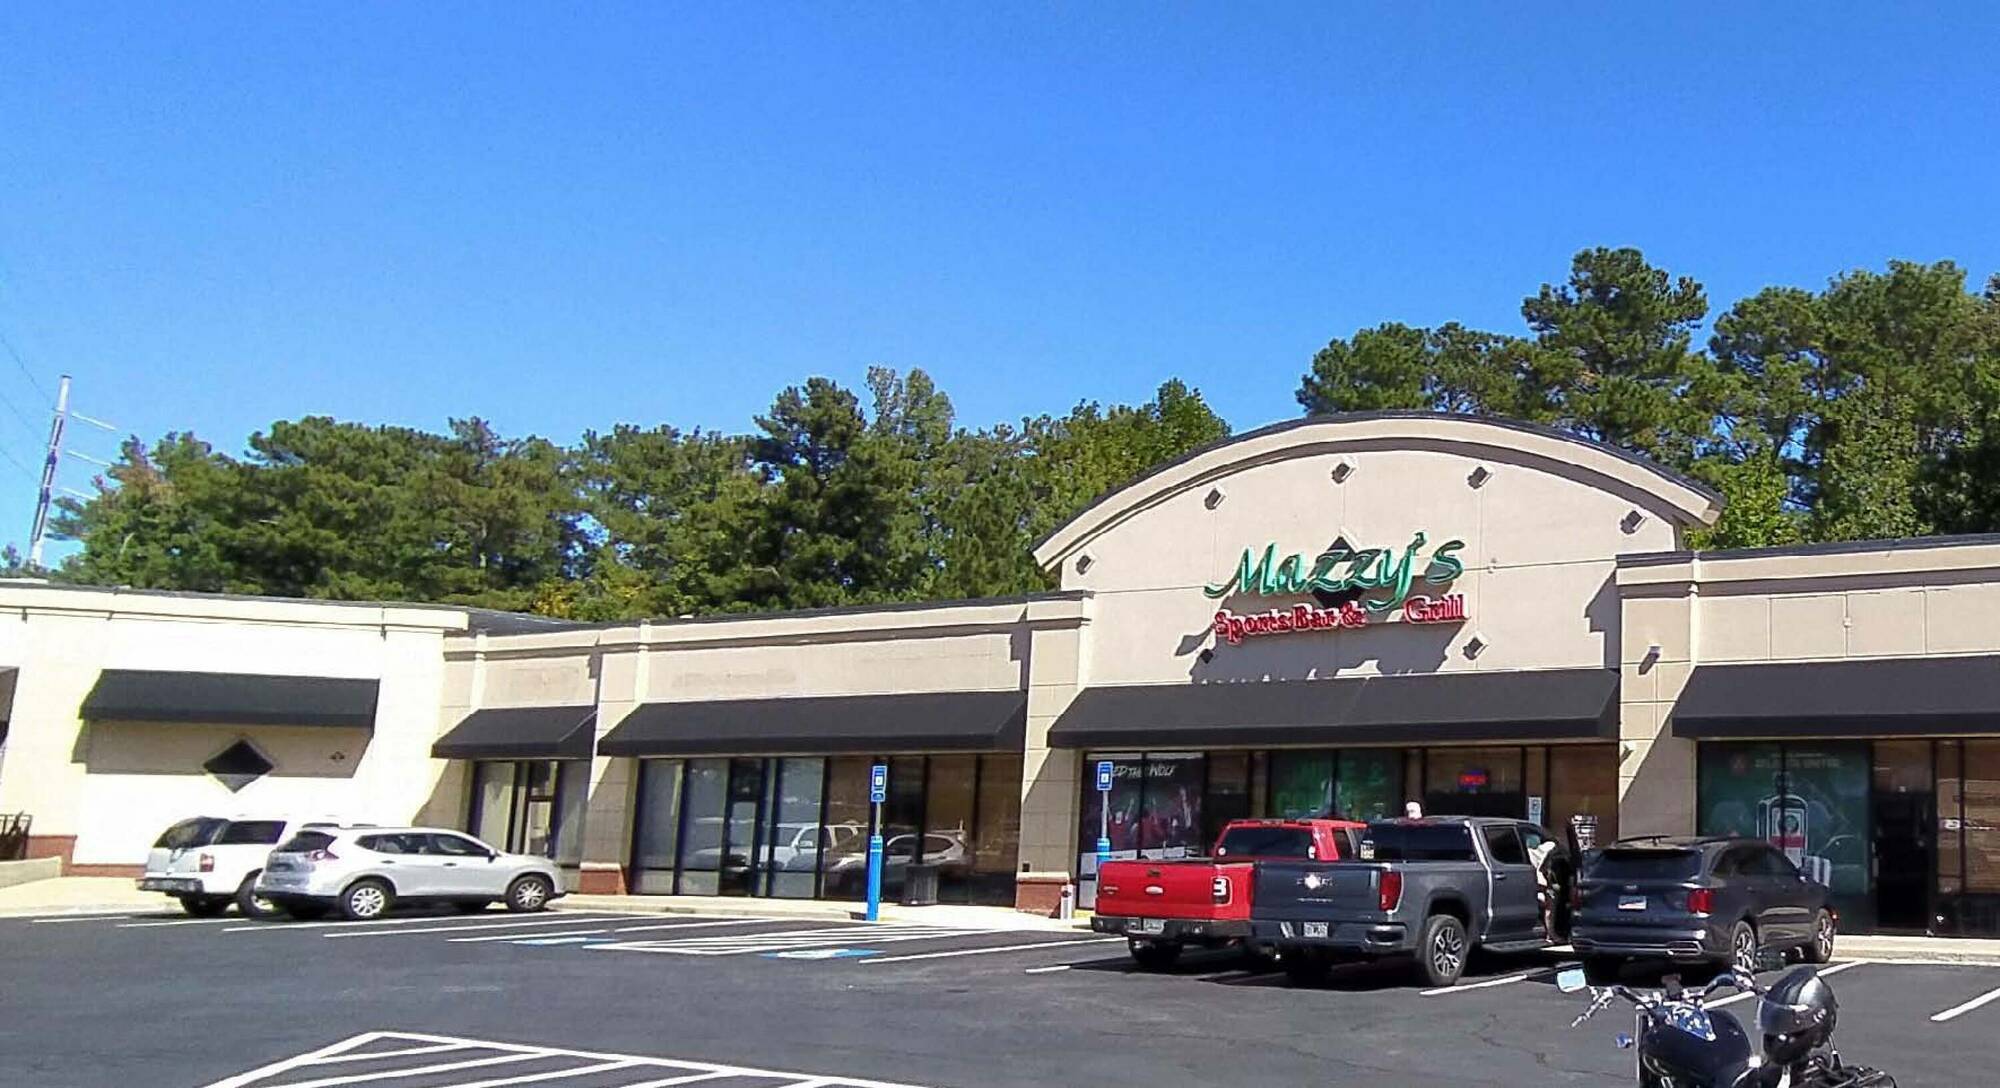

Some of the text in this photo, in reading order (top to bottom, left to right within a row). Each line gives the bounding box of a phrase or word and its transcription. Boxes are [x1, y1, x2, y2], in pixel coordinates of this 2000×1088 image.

[1203, 531, 1465, 612] Mazzy's
[1214, 593, 1466, 645] Sports Bar & Grill
